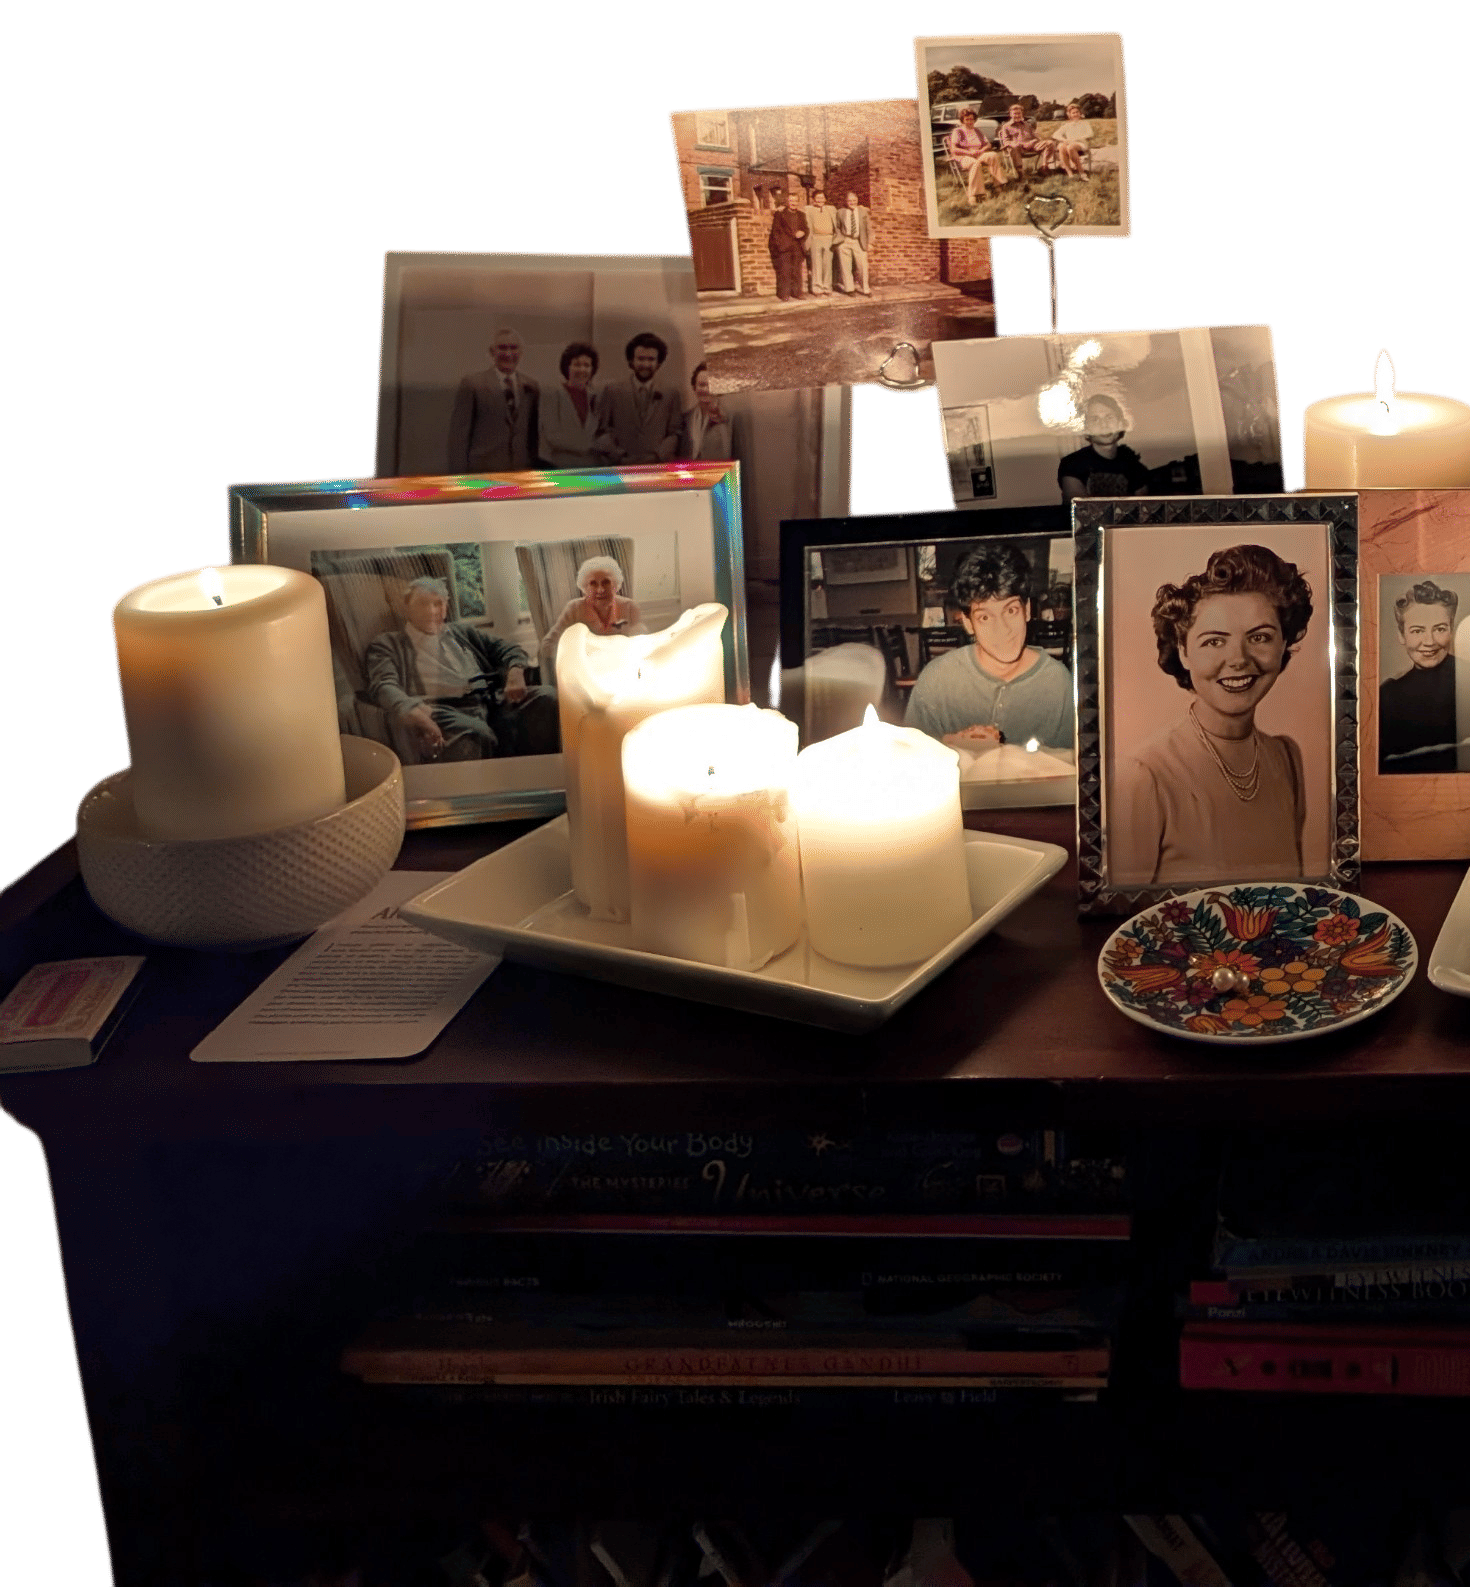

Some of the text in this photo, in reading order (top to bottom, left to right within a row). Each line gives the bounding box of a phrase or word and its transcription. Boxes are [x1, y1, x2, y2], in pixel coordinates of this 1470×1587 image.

[620, 1132, 678, 1157] Your
[686, 1133, 754, 1159] Body
[877, 1272, 1063, 1284] NATIONAL GEOGRAPHIC SOCIETY
[1246, 1285, 1401, 1303] EYEWITNESS
[823, 1356, 922, 1371] GANDHI
[590, 1388, 628, 1405] Irish
[631, 1388, 670, 1407] Fairy
[678, 1389, 715, 1405] Tales
[719, 1390, 732, 1405] &
[738, 1389, 801, 1406] Legends
[959, 1389, 997, 1404] Field
